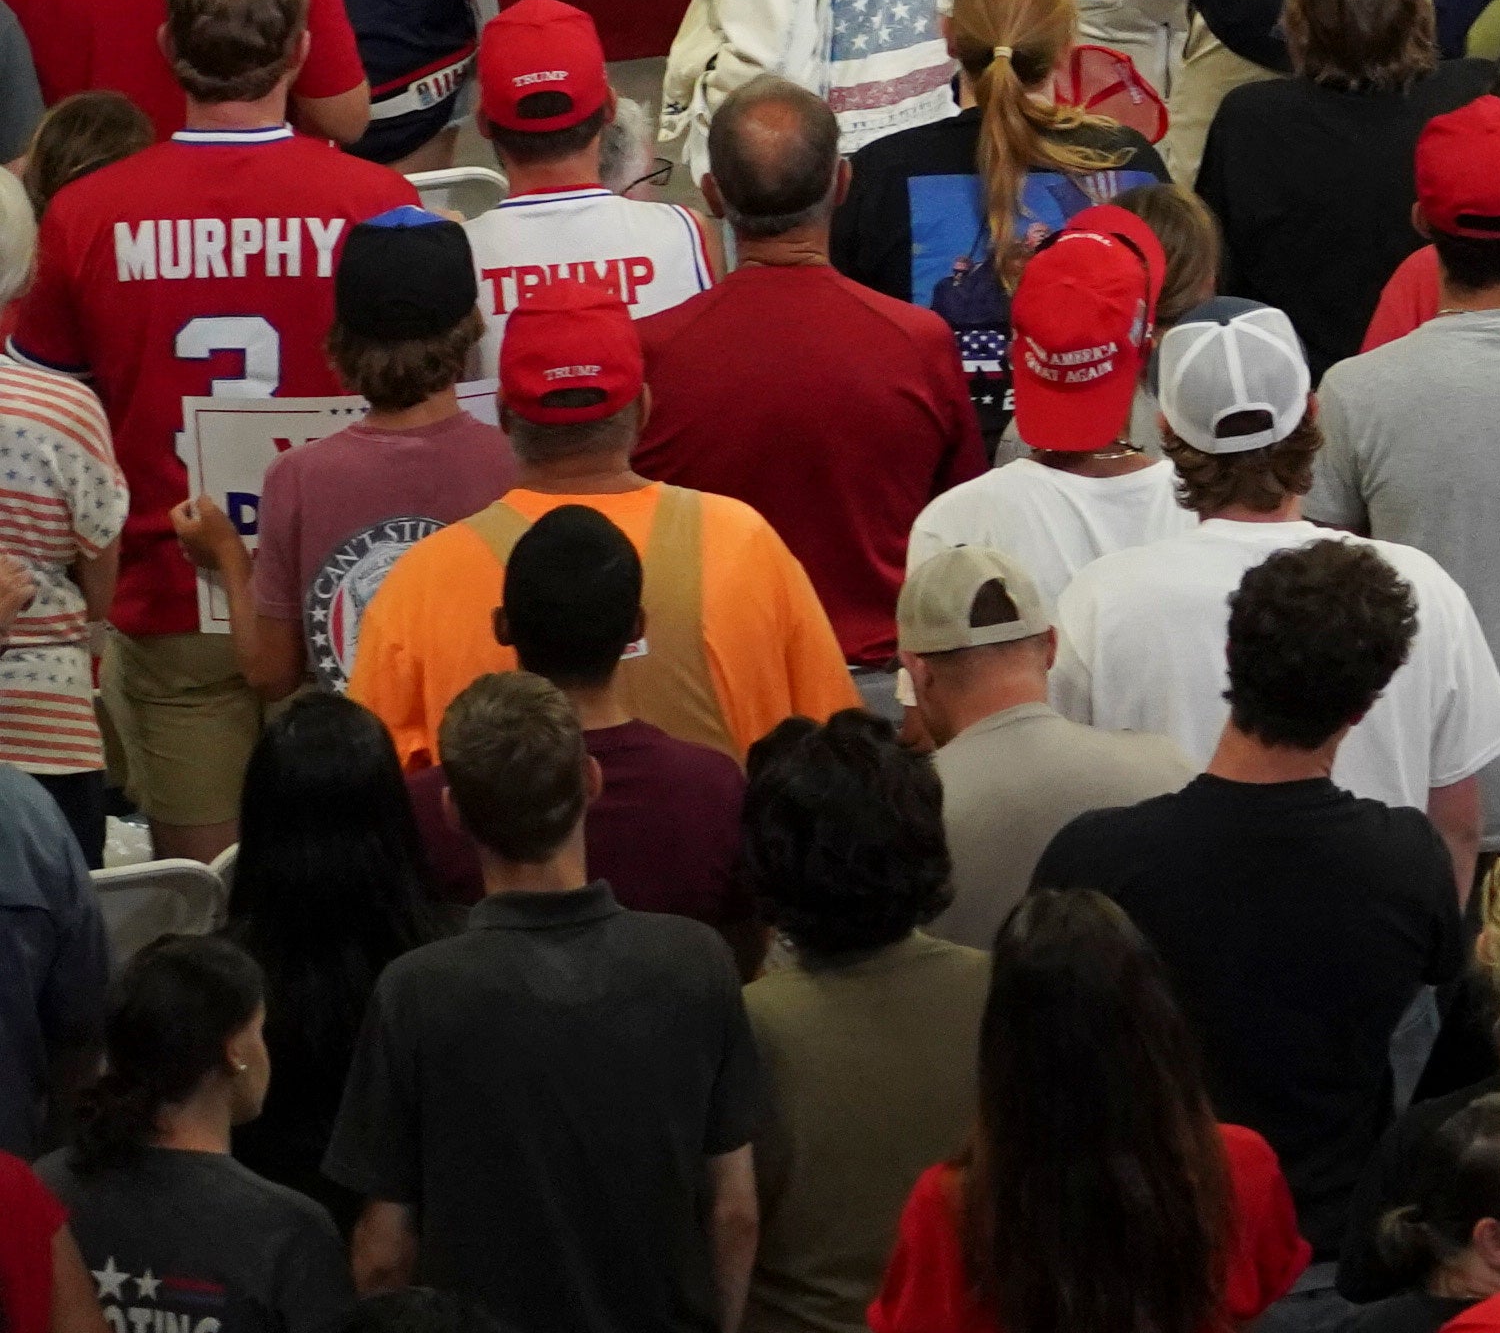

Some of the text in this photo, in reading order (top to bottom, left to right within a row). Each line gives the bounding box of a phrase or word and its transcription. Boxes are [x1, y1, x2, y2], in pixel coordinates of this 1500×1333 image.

[512, 71, 568, 87] TRUMP
[114, 218, 347, 283] MURPHY
[482, 257, 653, 317] TRUMP
[1049, 342, 1117, 366] AMERICA
[543, 365, 601, 381] TRUMP
[1065, 360, 1113, 384] AGAIN
[313, 527, 376, 599] CAN'T
